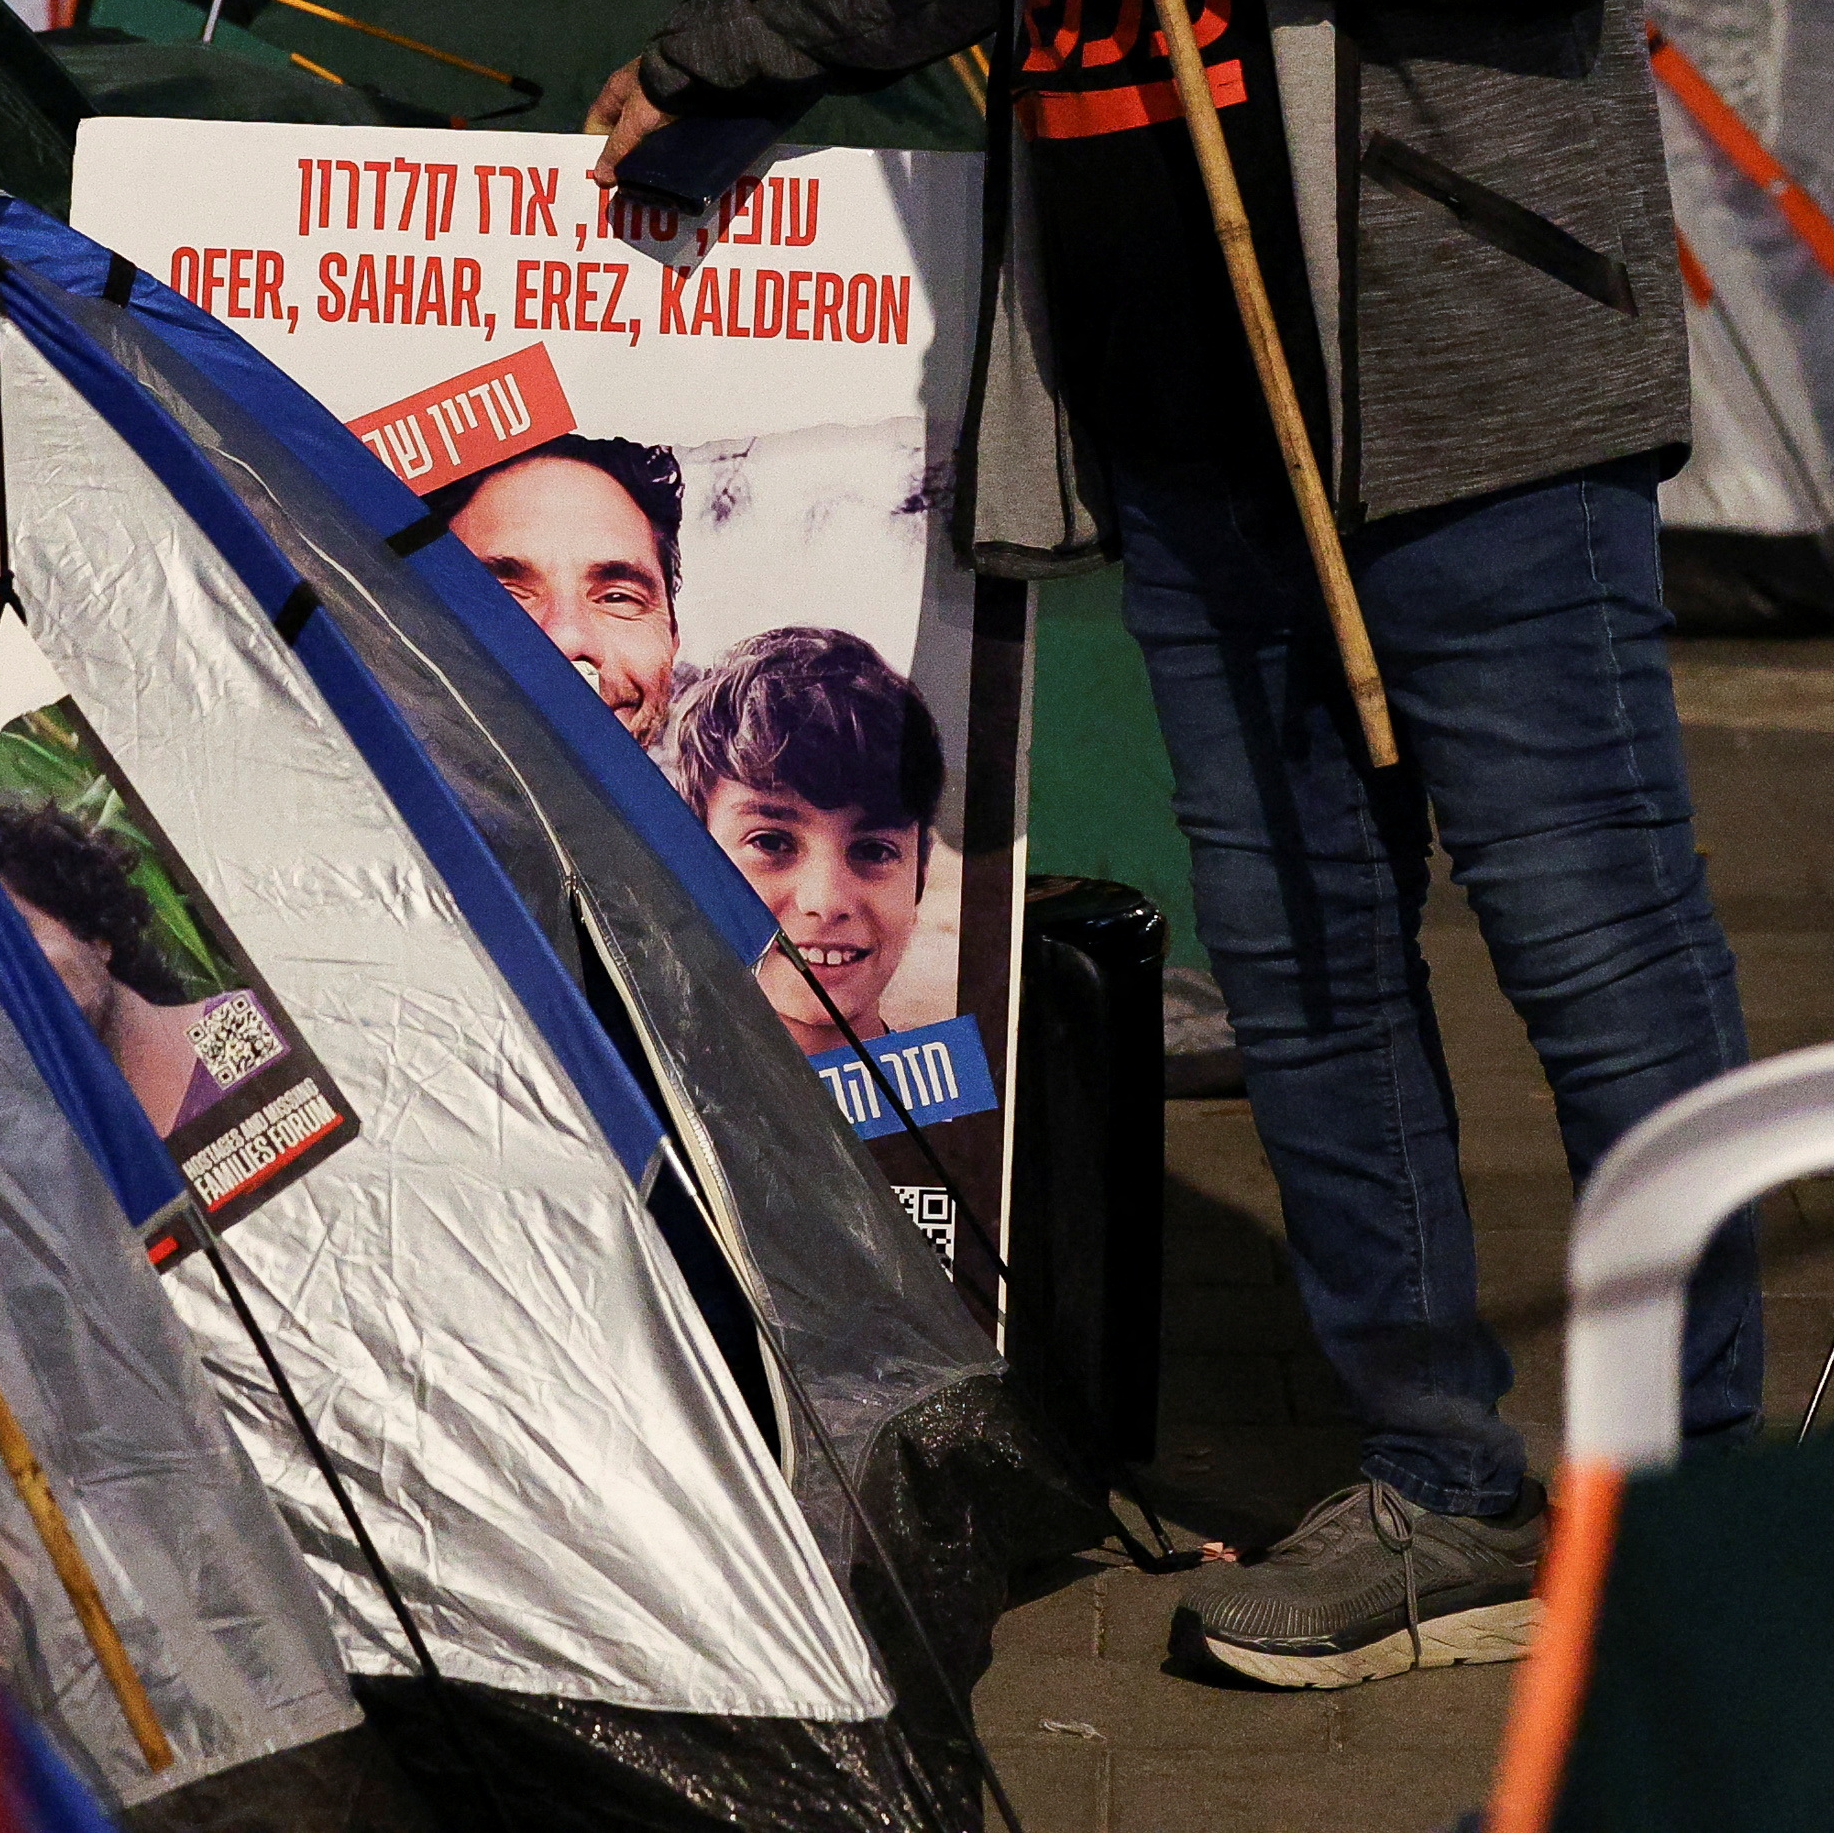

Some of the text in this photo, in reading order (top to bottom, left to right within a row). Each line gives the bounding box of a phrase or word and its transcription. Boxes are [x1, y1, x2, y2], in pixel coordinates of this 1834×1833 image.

[298, 157, 458, 241] קלדרון
[474, 165, 559, 237] ארז
[317, 251, 496, 341] SAHAR,
[514, 260, 642, 347] EREZ,
[659, 265, 911, 345] KALDERON
[426, 372, 532, 466] עדיין
[879, 1041, 959, 1111] חזר
[193, 1094, 339, 1206] FAMILIES FORUM
